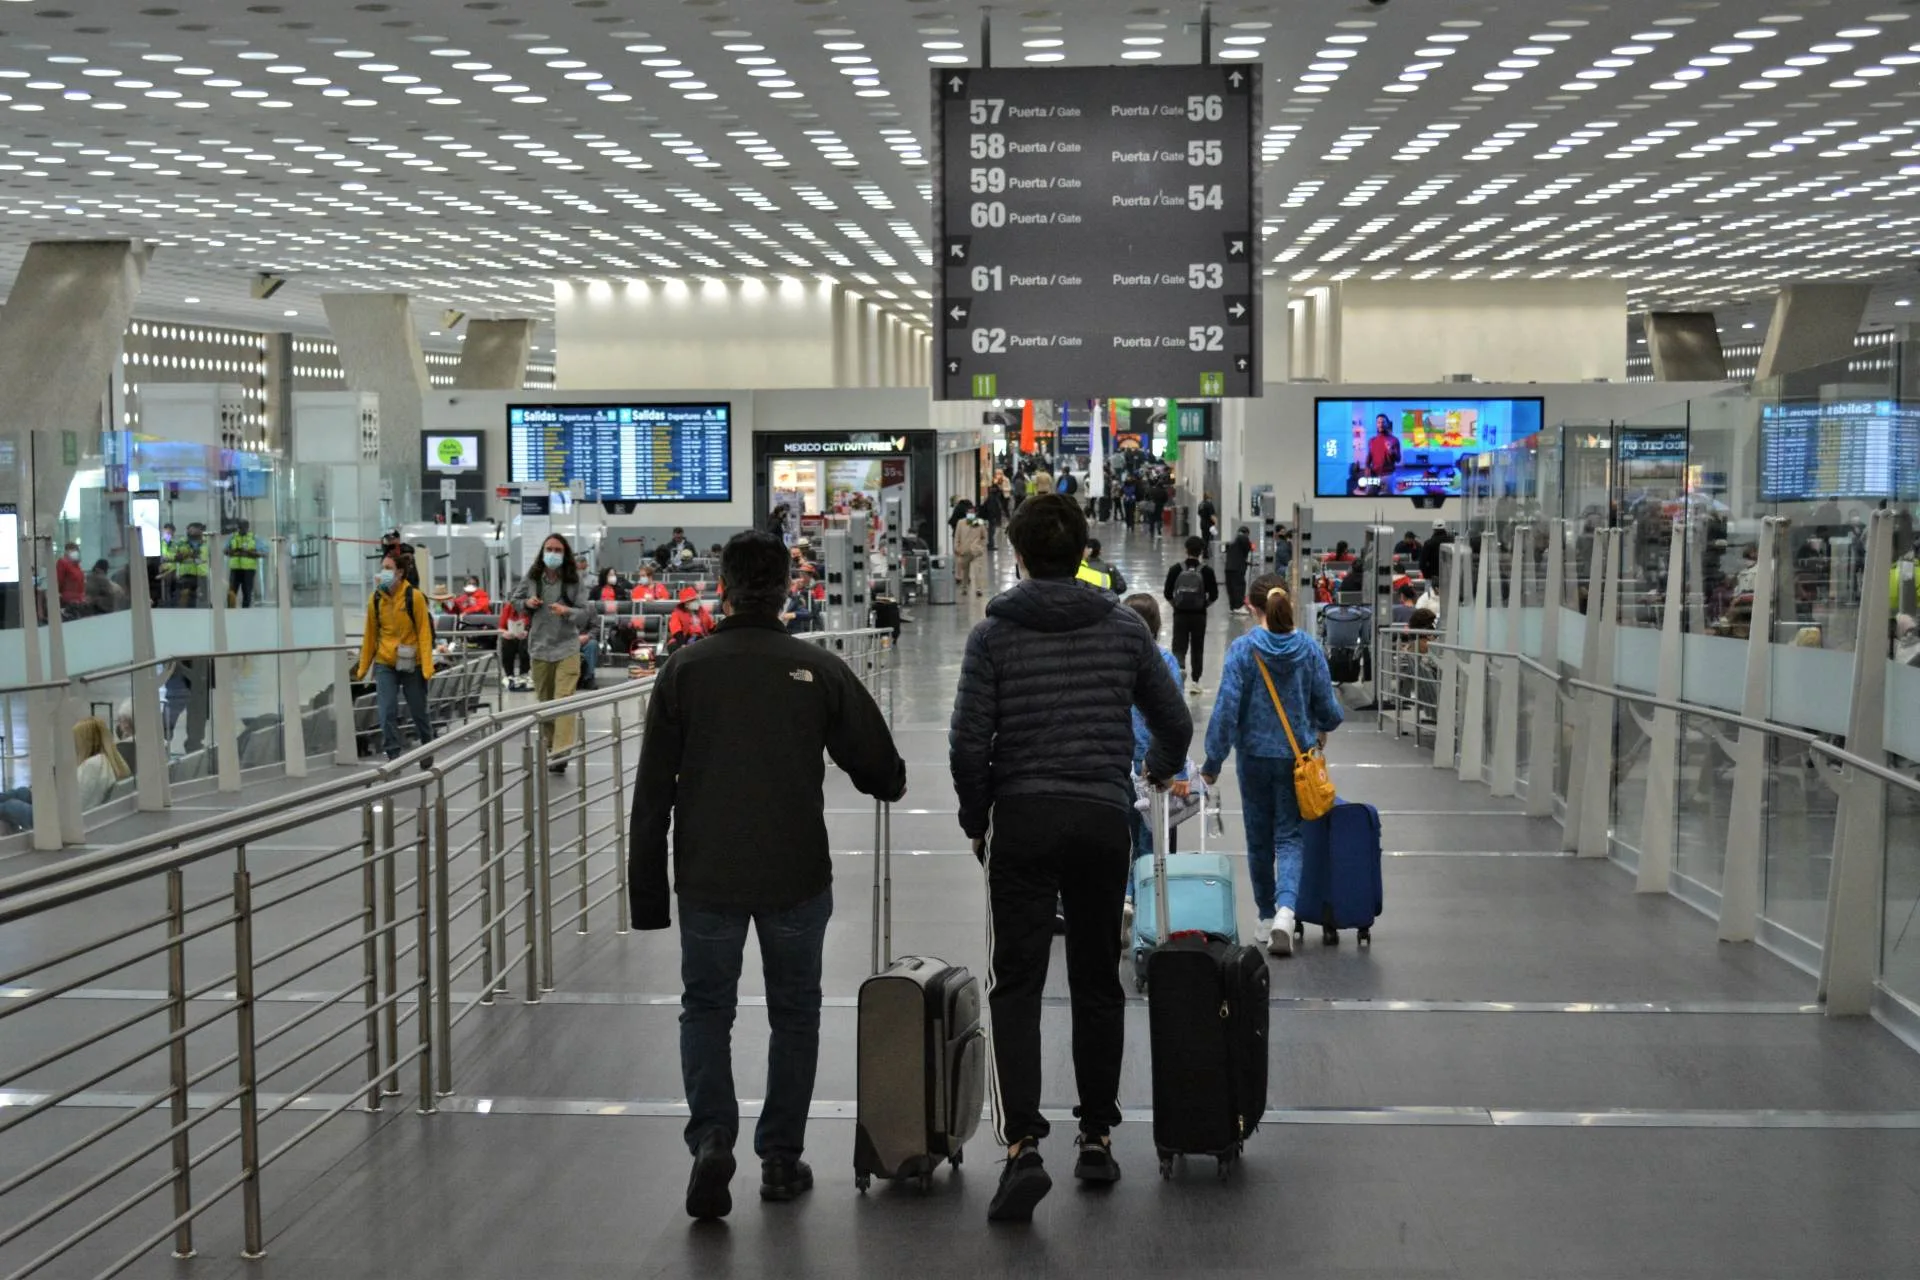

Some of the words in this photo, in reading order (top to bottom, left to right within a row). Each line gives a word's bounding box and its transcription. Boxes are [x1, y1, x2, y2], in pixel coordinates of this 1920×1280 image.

[970, 99, 1005, 124] 57
[1008, 105, 1047, 118] Puerta
[1057, 106, 1082, 118] Gate
[1112, 105, 1150, 117] Puerta
[1160, 105, 1184, 117] Gate
[1187, 95, 1223, 121] 56
[970, 133, 1006, 159] 58
[1009, 141, 1048, 153] Puerta
[1057, 141, 1082, 153] Gate
[1112, 151, 1150, 163] Puerta
[1160, 151, 1184, 162] Gate
[1187, 140, 1223, 166] 55
[970, 167, 1007, 193] 59
[1009, 177, 1048, 189] Puerta
[1057, 177, 1082, 189] Gate
[1112, 195, 1150, 207] Puerta
[1160, 195, 1185, 206] Gate
[1188, 185, 1223, 211] 54
[970, 201, 1007, 227] 60
[1009, 212, 1048, 224] Puerta
[1057, 212, 1082, 224] Gate
[971, 266, 1003, 291] 61
[1010, 274, 1048, 287] Puerta
[1058, 274, 1082, 286] Gate
[1113, 274, 1151, 286] Puerta
[1161, 274, 1185, 285] Gate
[1188, 263, 1224, 290] 53
[971, 328, 1007, 354] 62
[1010, 335, 1049, 347] Puerta
[1058, 335, 1083, 347] Gate
[1113, 336, 1151, 348] Puerta
[1161, 336, 1185, 348] Gate
[1188, 325, 1224, 352] 52
[524, 410, 557, 421] Salidas
[632, 409, 665, 421] Salidas
[785, 443, 821, 452] MEXICO
